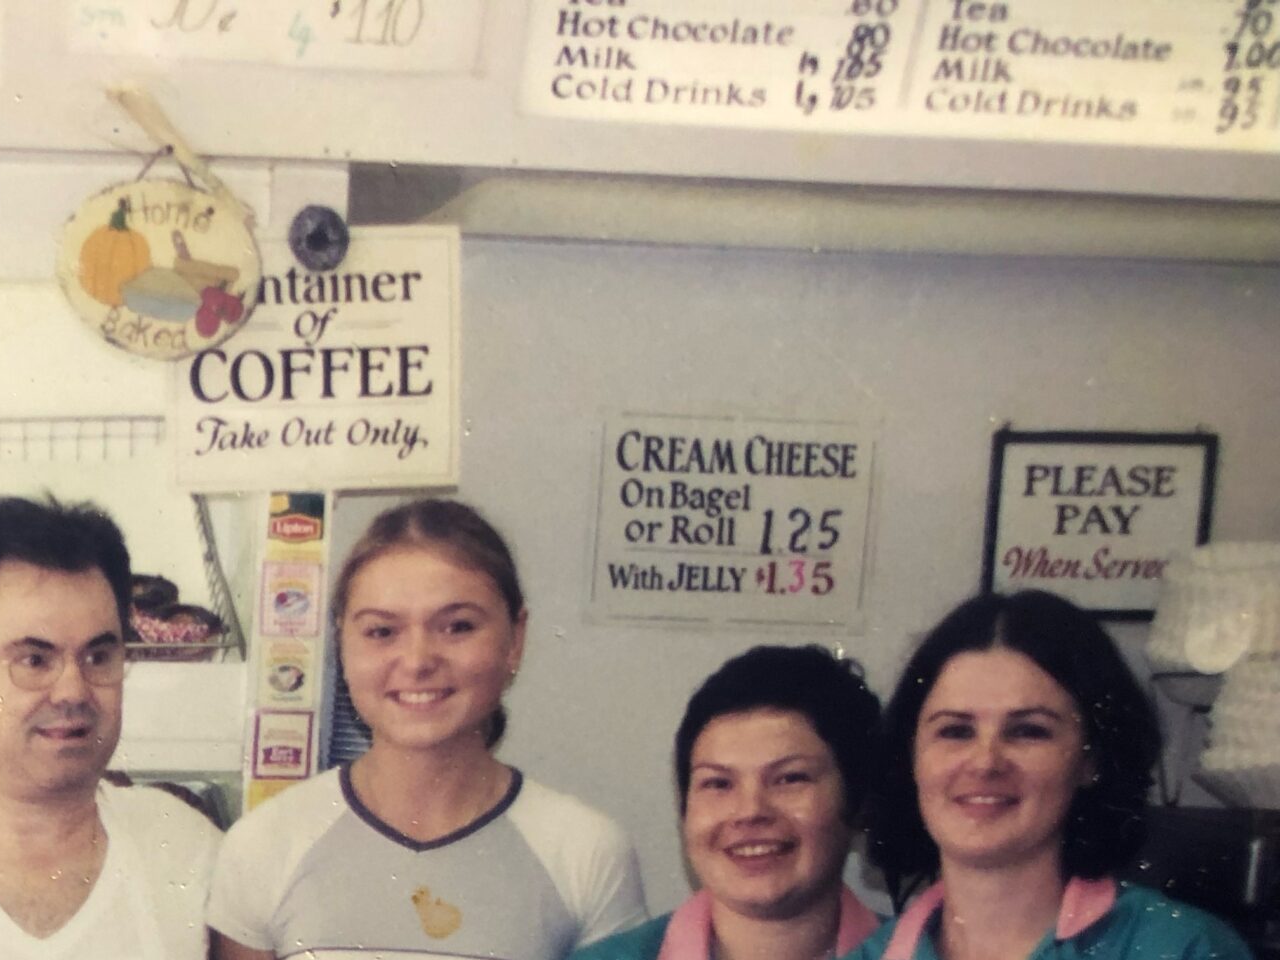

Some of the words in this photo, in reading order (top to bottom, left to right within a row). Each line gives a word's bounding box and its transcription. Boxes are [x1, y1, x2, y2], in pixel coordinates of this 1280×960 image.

[556, 10, 618, 38] Hot
[627, 14, 795, 46] Chocolate
[938, 25, 997, 53] Hot
[1007, 28, 1173, 63] Chocolate
[555, 45, 637, 71] Milk
[932, 58, 1013, 84] Milk
[551, 74, 632, 104] Cold
[645, 78, 767, 108] Drinks
[925, 88, 1008, 115] Cold
[1016, 89, 1139, 121] Drinks
[257, 267, 422, 305] ntainer
[99, 305, 187, 349] Baked
[294, 307, 338, 347] Of
[190, 345, 433, 403] COFFEE
[195, 416, 269, 457] Take
[281, 417, 334, 447] Out
[616, 430, 738, 474] CREAM
[745, 435, 857, 479] CHEESE
[621, 478, 665, 508] On
[670, 481, 751, 518] Bagel
[1023, 465, 1177, 498] PLEASE
[276, 520, 314, 537] Lipton
[624, 519, 662, 543] or
[670, 516, 735, 546] Roll
[1053, 504, 1140, 536] PAY
[608, 563, 663, 591] With
[667, 563, 747, 593] JELLY
[1002, 546, 1080, 580] When
